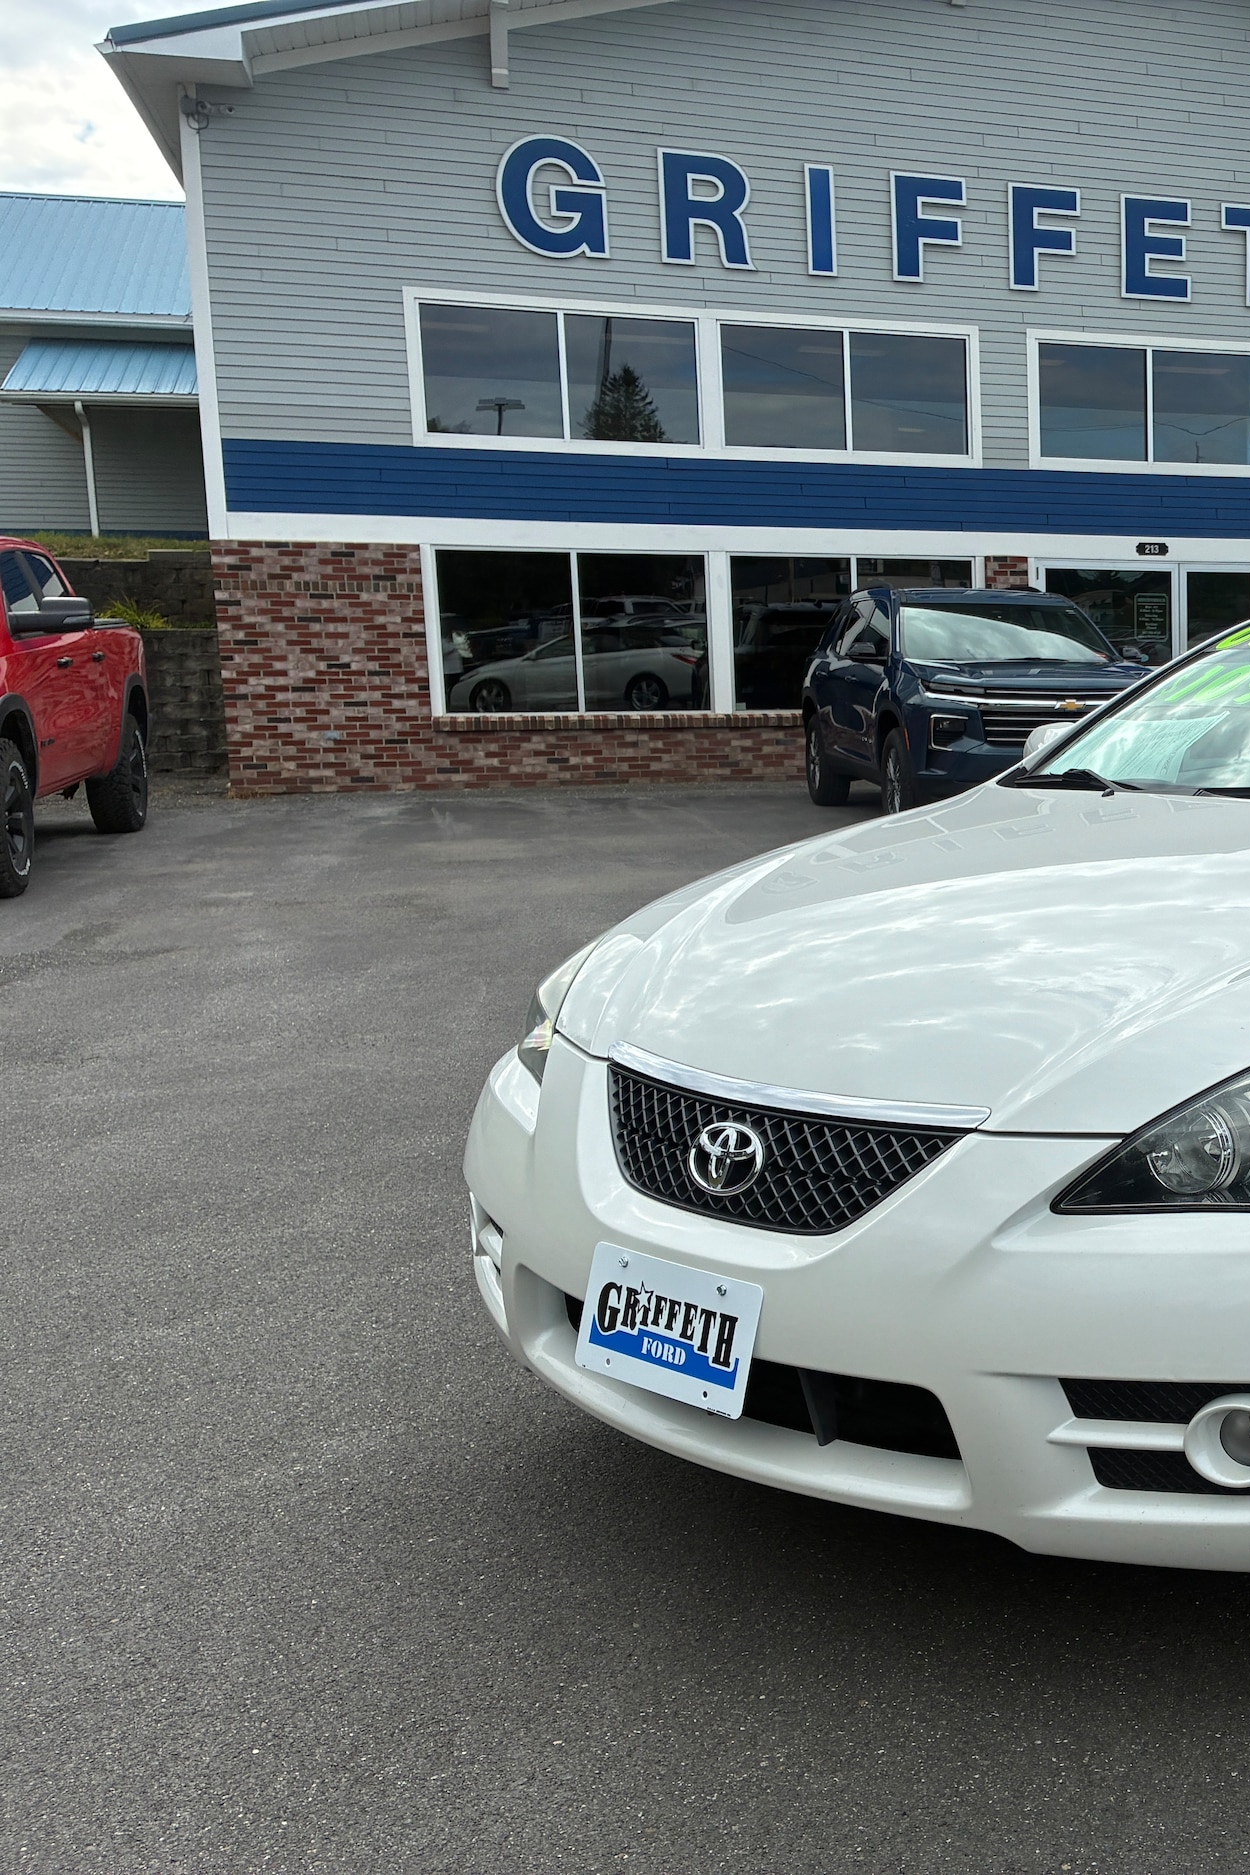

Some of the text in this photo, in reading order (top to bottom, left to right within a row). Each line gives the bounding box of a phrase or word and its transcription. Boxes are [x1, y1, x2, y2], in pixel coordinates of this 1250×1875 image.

[1144, 544, 1160, 554] 213
[597, 1281, 739, 1369] GRIFFETH
[640, 1336, 687, 1367] FORD
